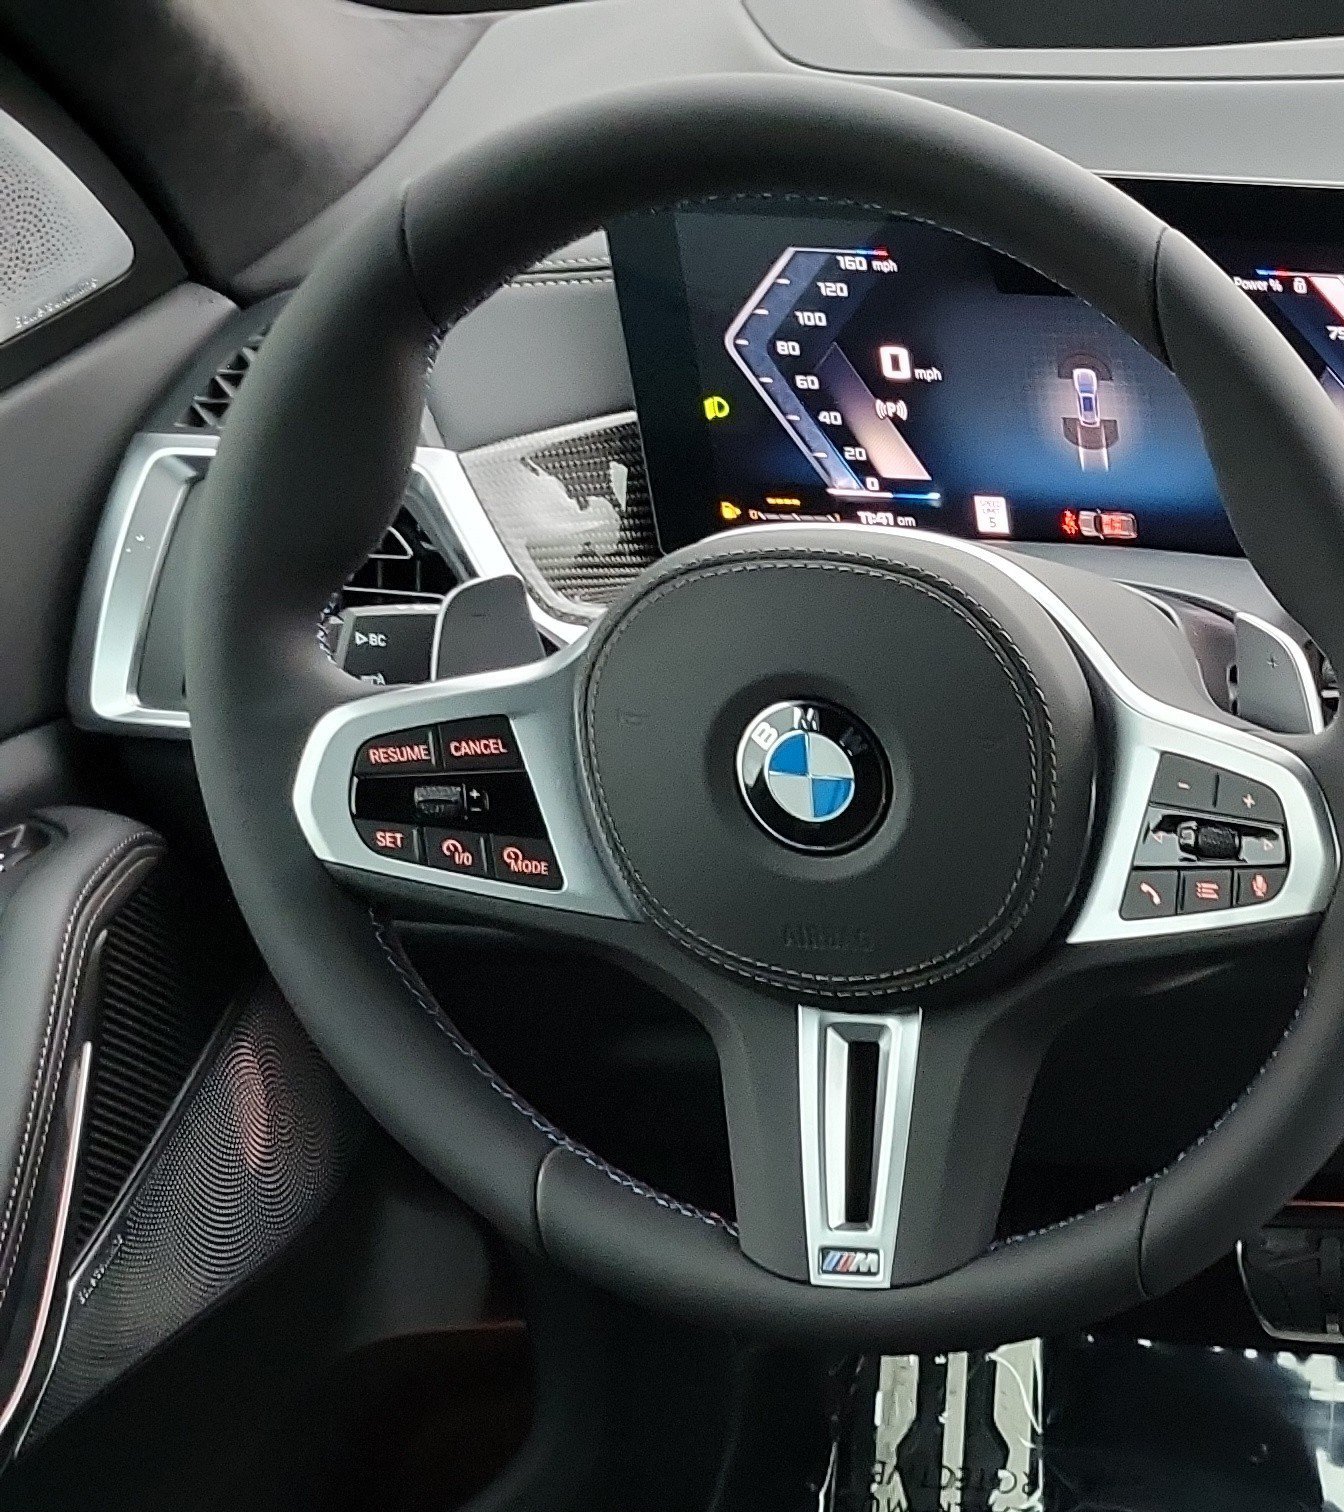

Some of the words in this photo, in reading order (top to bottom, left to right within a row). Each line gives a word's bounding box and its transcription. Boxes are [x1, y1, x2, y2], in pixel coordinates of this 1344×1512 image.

[836, 255, 868, 271] 160
[871, 258, 899, 273] mph
[816, 281, 848, 297] 120
[1233, 276, 1268, 292] Power
[1268, 278, 1283, 293] %
[795, 311, 827, 327] 100
[775, 340, 800, 356] 80
[879, 345, 912, 380] 0
[914, 367, 942, 382] mph
[795, 374, 820, 390] 60
[818, 411, 842, 426] 40
[843, 446, 867, 461] 20
[865, 477, 879, 491] 0
[897, 515, 917, 527] am
[989, 516, 997, 528] 5
[369, 633, 387, 647] BC
[368, 744, 430, 764] RESUME
[449, 739, 507, 757] CANCEL
[375, 832, 403, 849] SET
[510, 858, 549, 875] MODE
